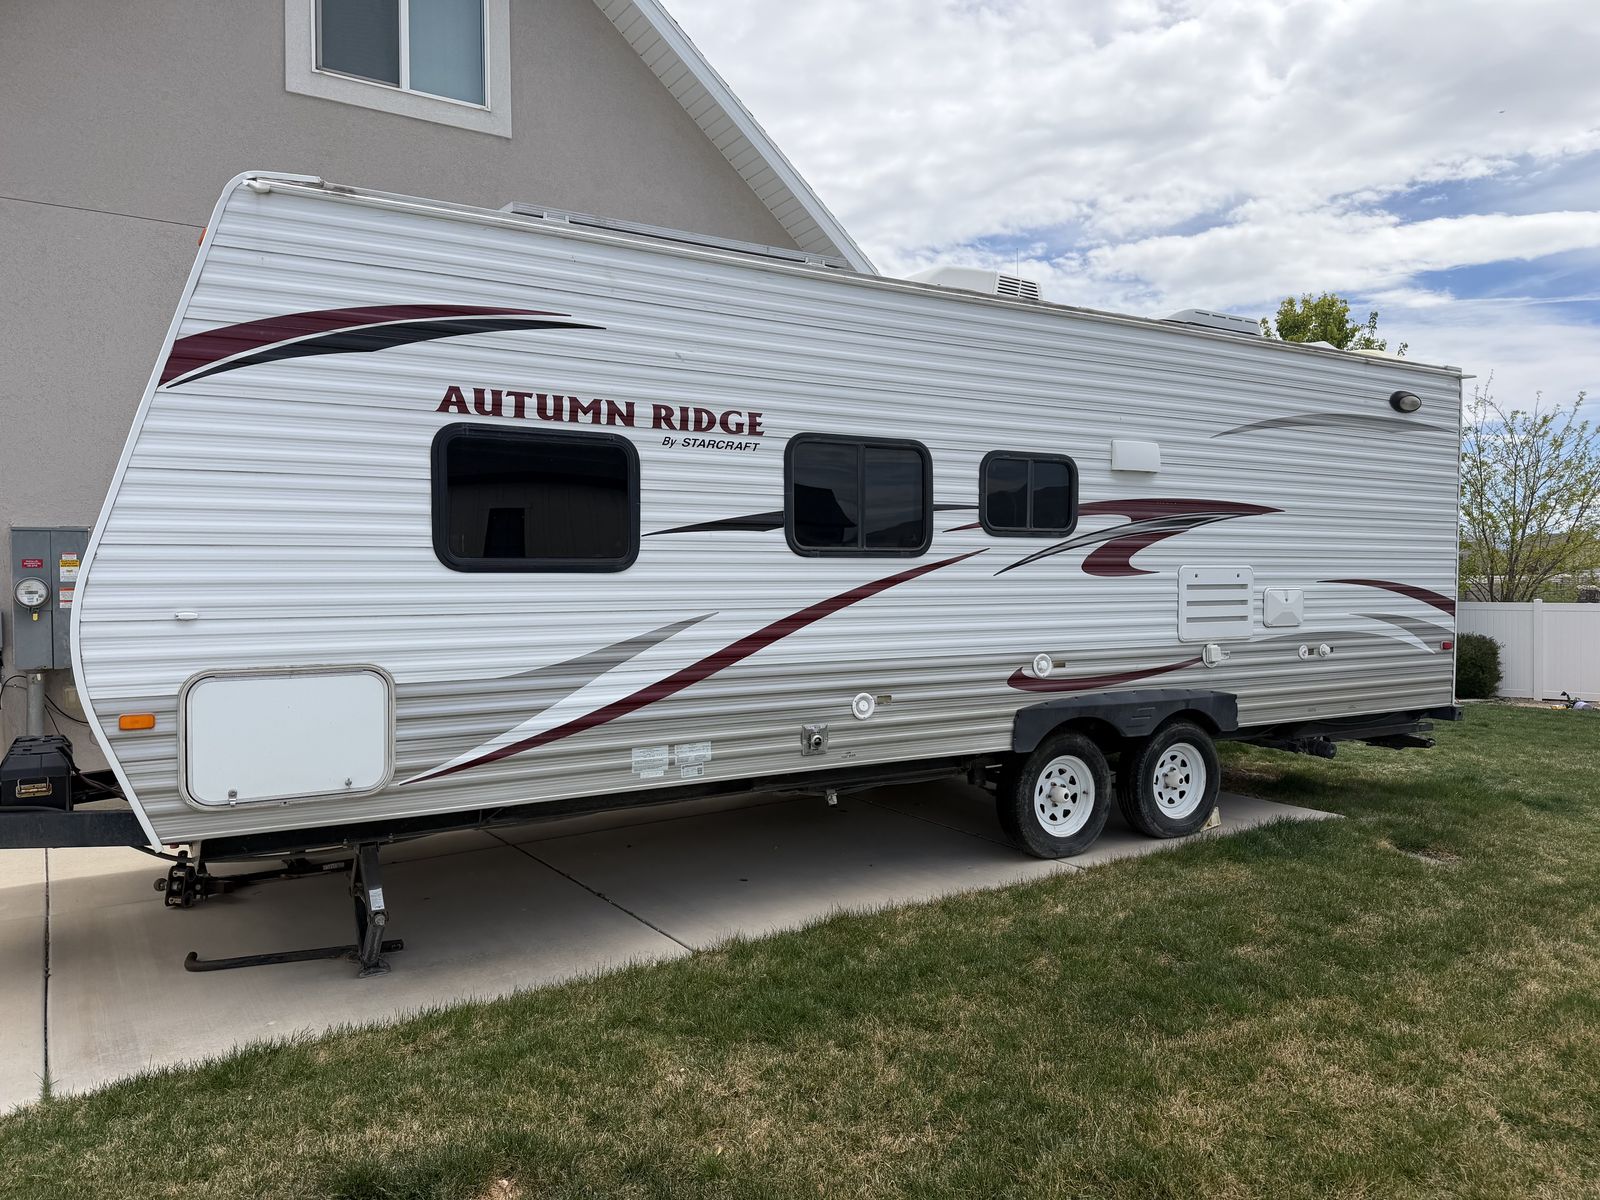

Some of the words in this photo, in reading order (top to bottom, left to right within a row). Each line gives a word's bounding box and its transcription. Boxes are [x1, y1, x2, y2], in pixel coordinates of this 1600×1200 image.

[434, 385, 636, 427] AUTUMN
[651, 403, 765, 437] RIDGE
[662, 436, 676, 449] By
[681, 437, 760, 452] STARCRAFT
